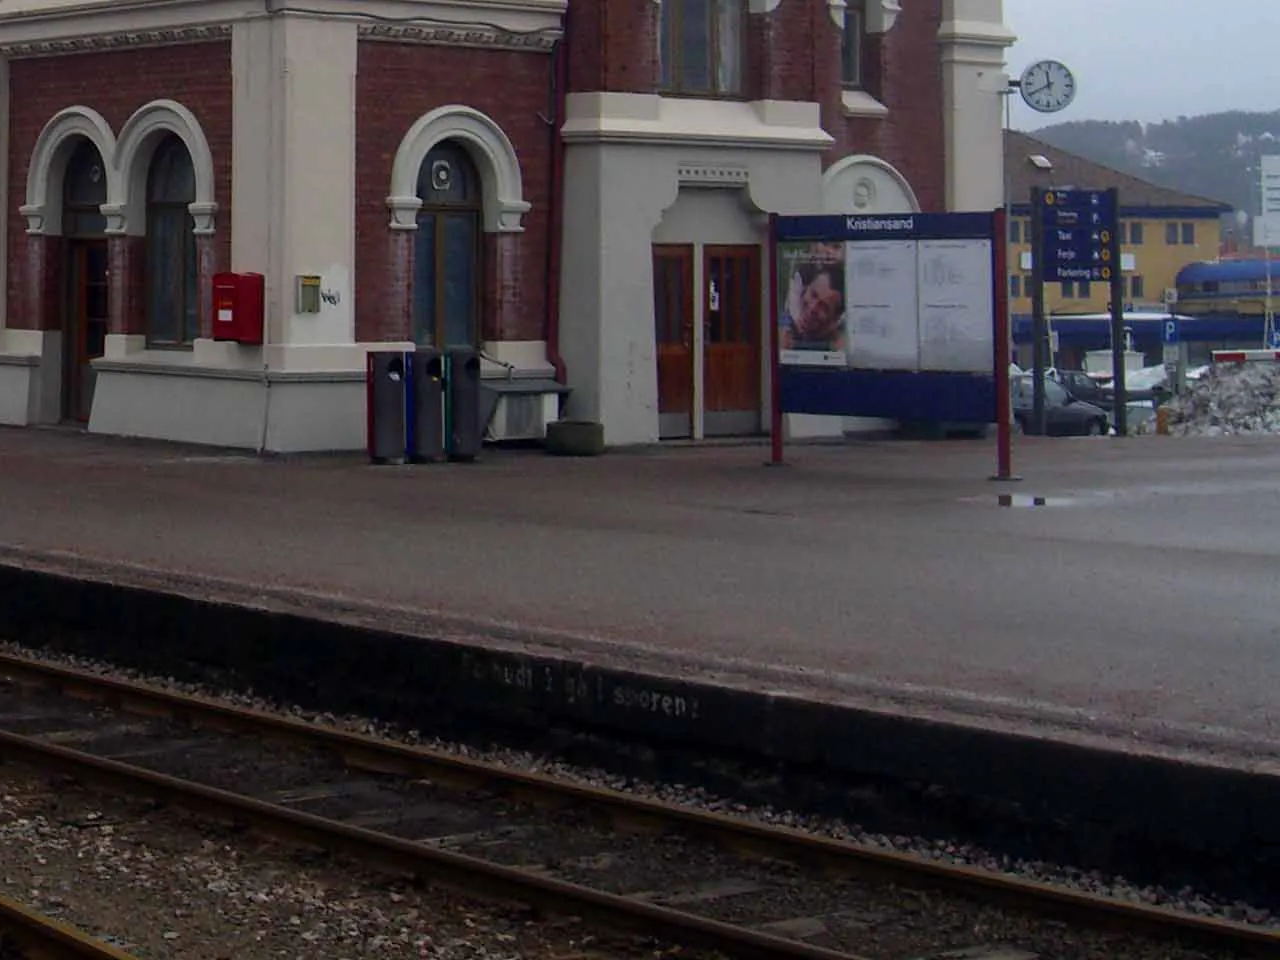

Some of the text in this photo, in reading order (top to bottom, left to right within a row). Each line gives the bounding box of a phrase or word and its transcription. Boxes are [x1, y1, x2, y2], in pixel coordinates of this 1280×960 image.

[846, 216, 913, 230] Kristiansand
[1057, 266, 1091, 279] Parkering
[1165, 321, 1176, 341] P
